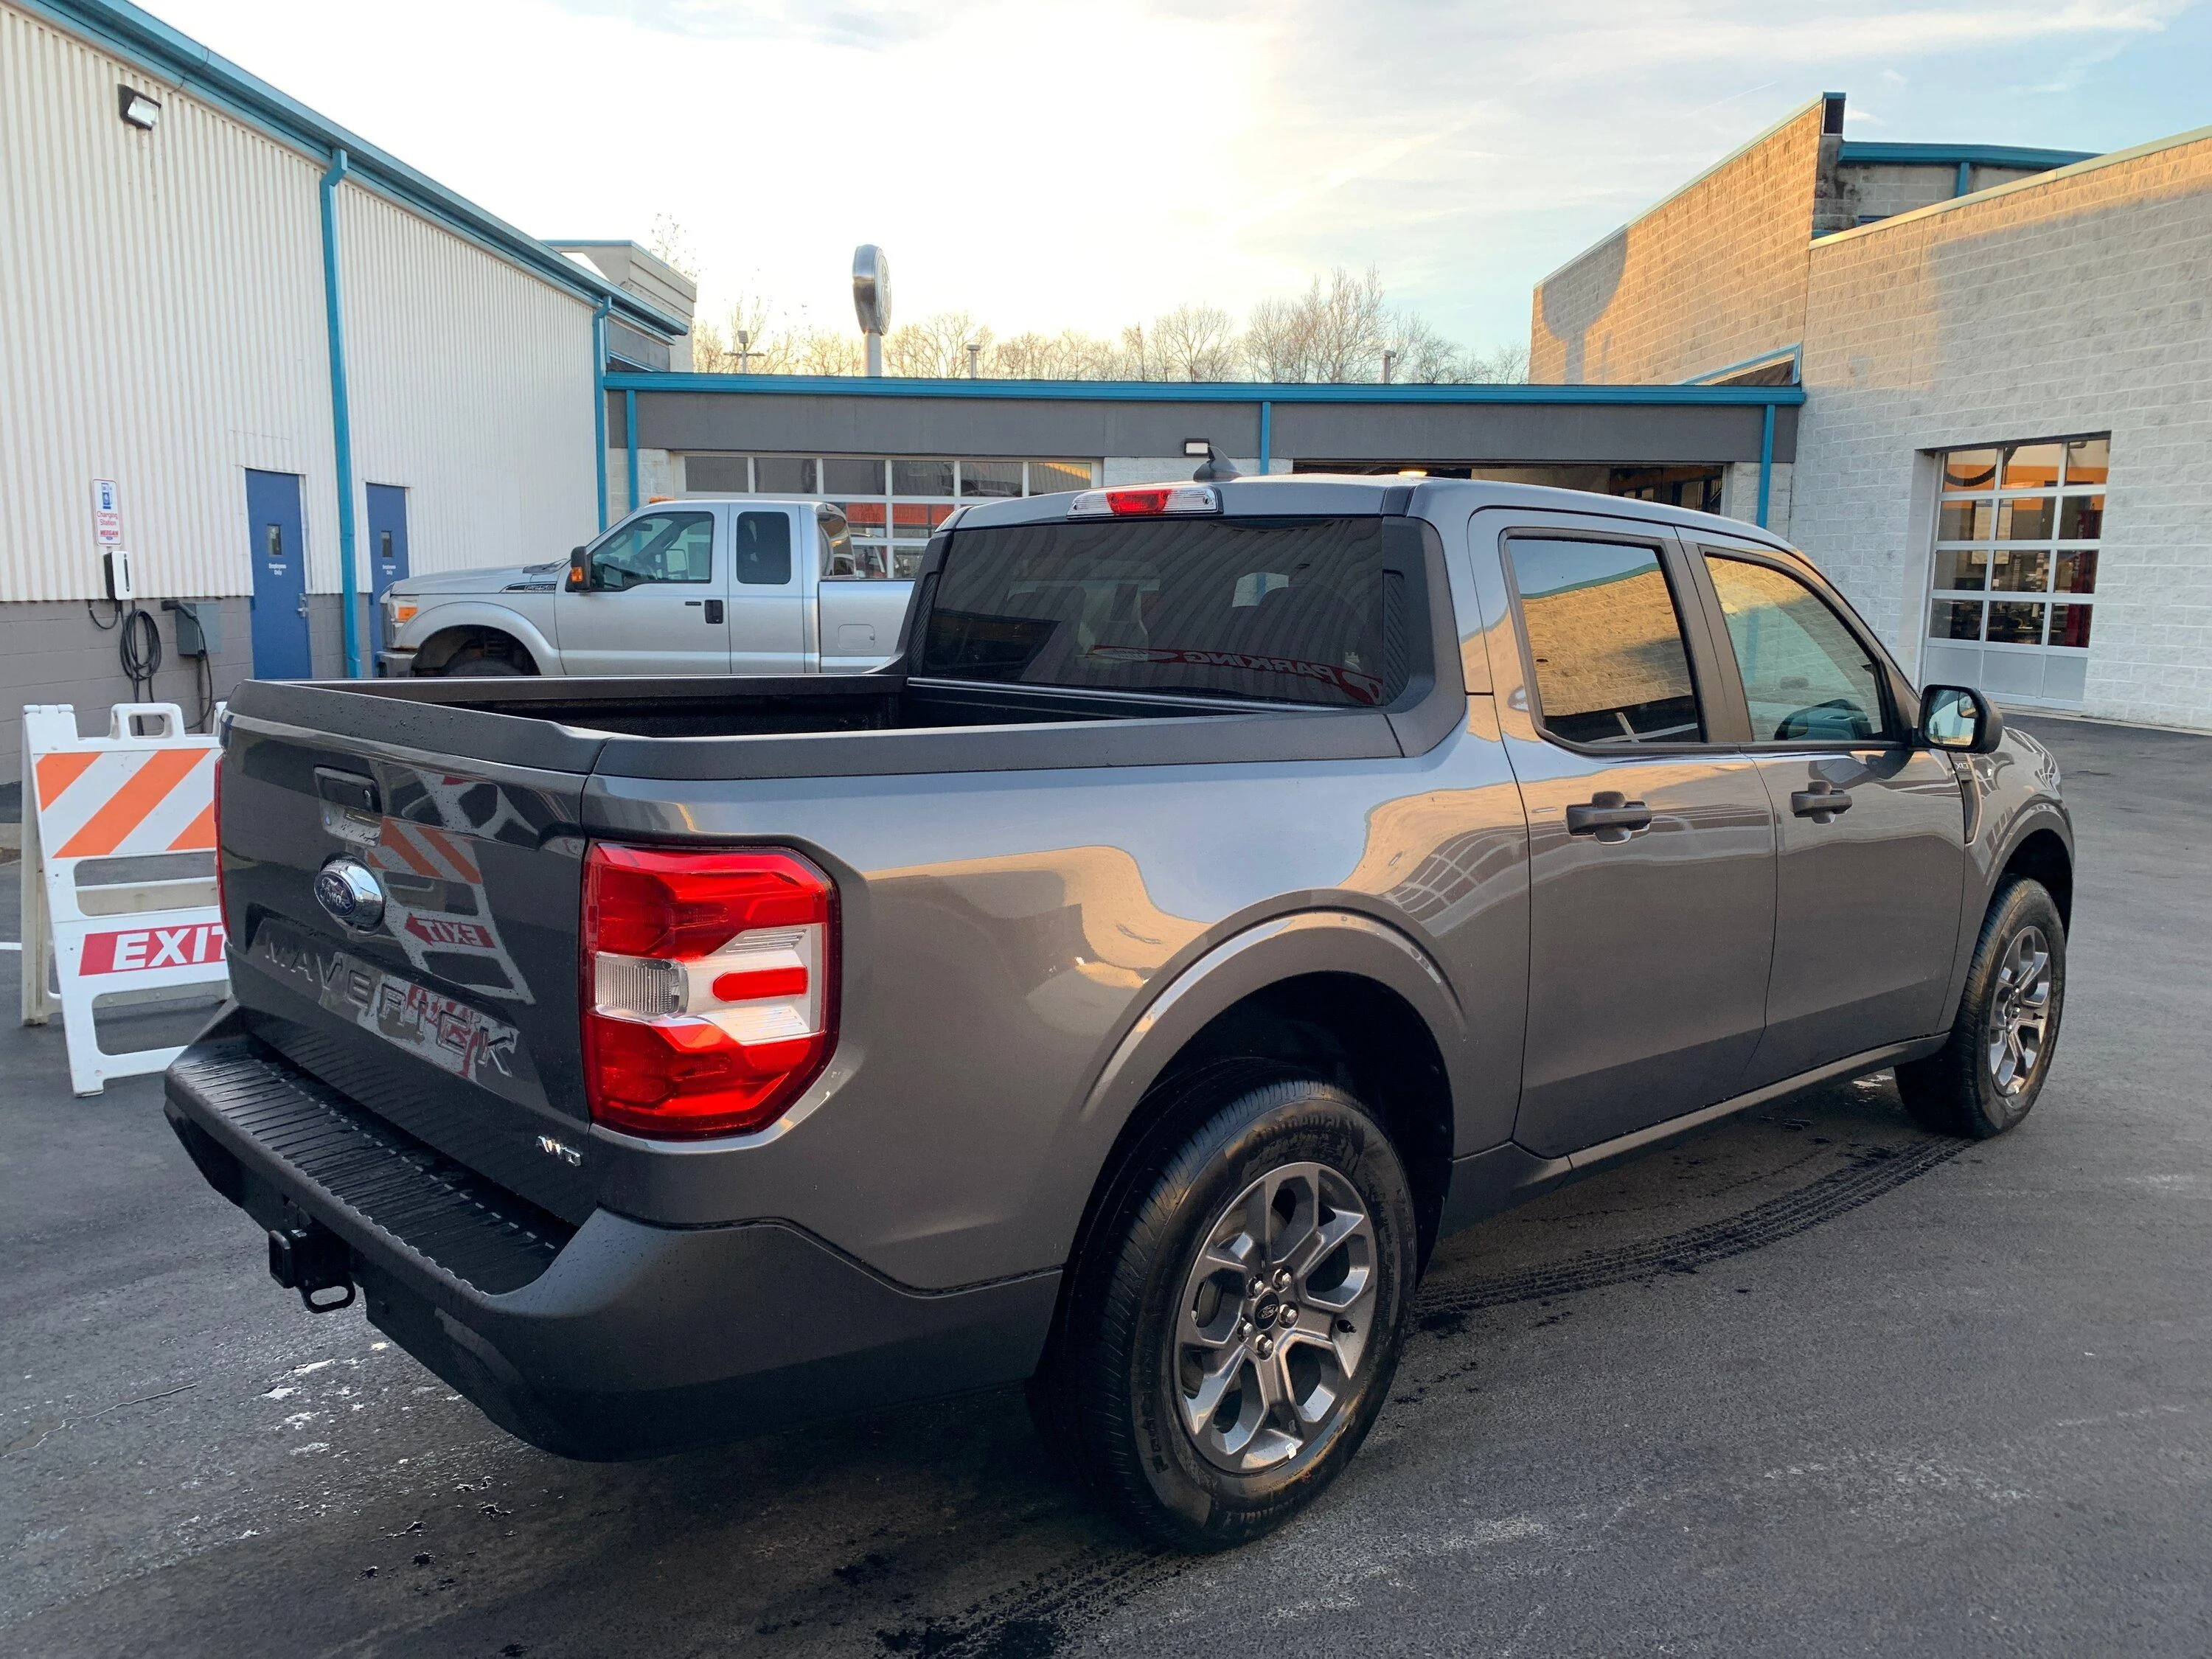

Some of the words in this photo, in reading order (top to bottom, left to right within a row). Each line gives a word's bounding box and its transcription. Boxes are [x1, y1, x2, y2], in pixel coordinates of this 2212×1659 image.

[97, 511, 118, 519] Charging
[319, 875, 352, 911] Ford
[262, 932, 515, 1077] MAVERICK
[1259, 1305, 1276, 1318] Ford
